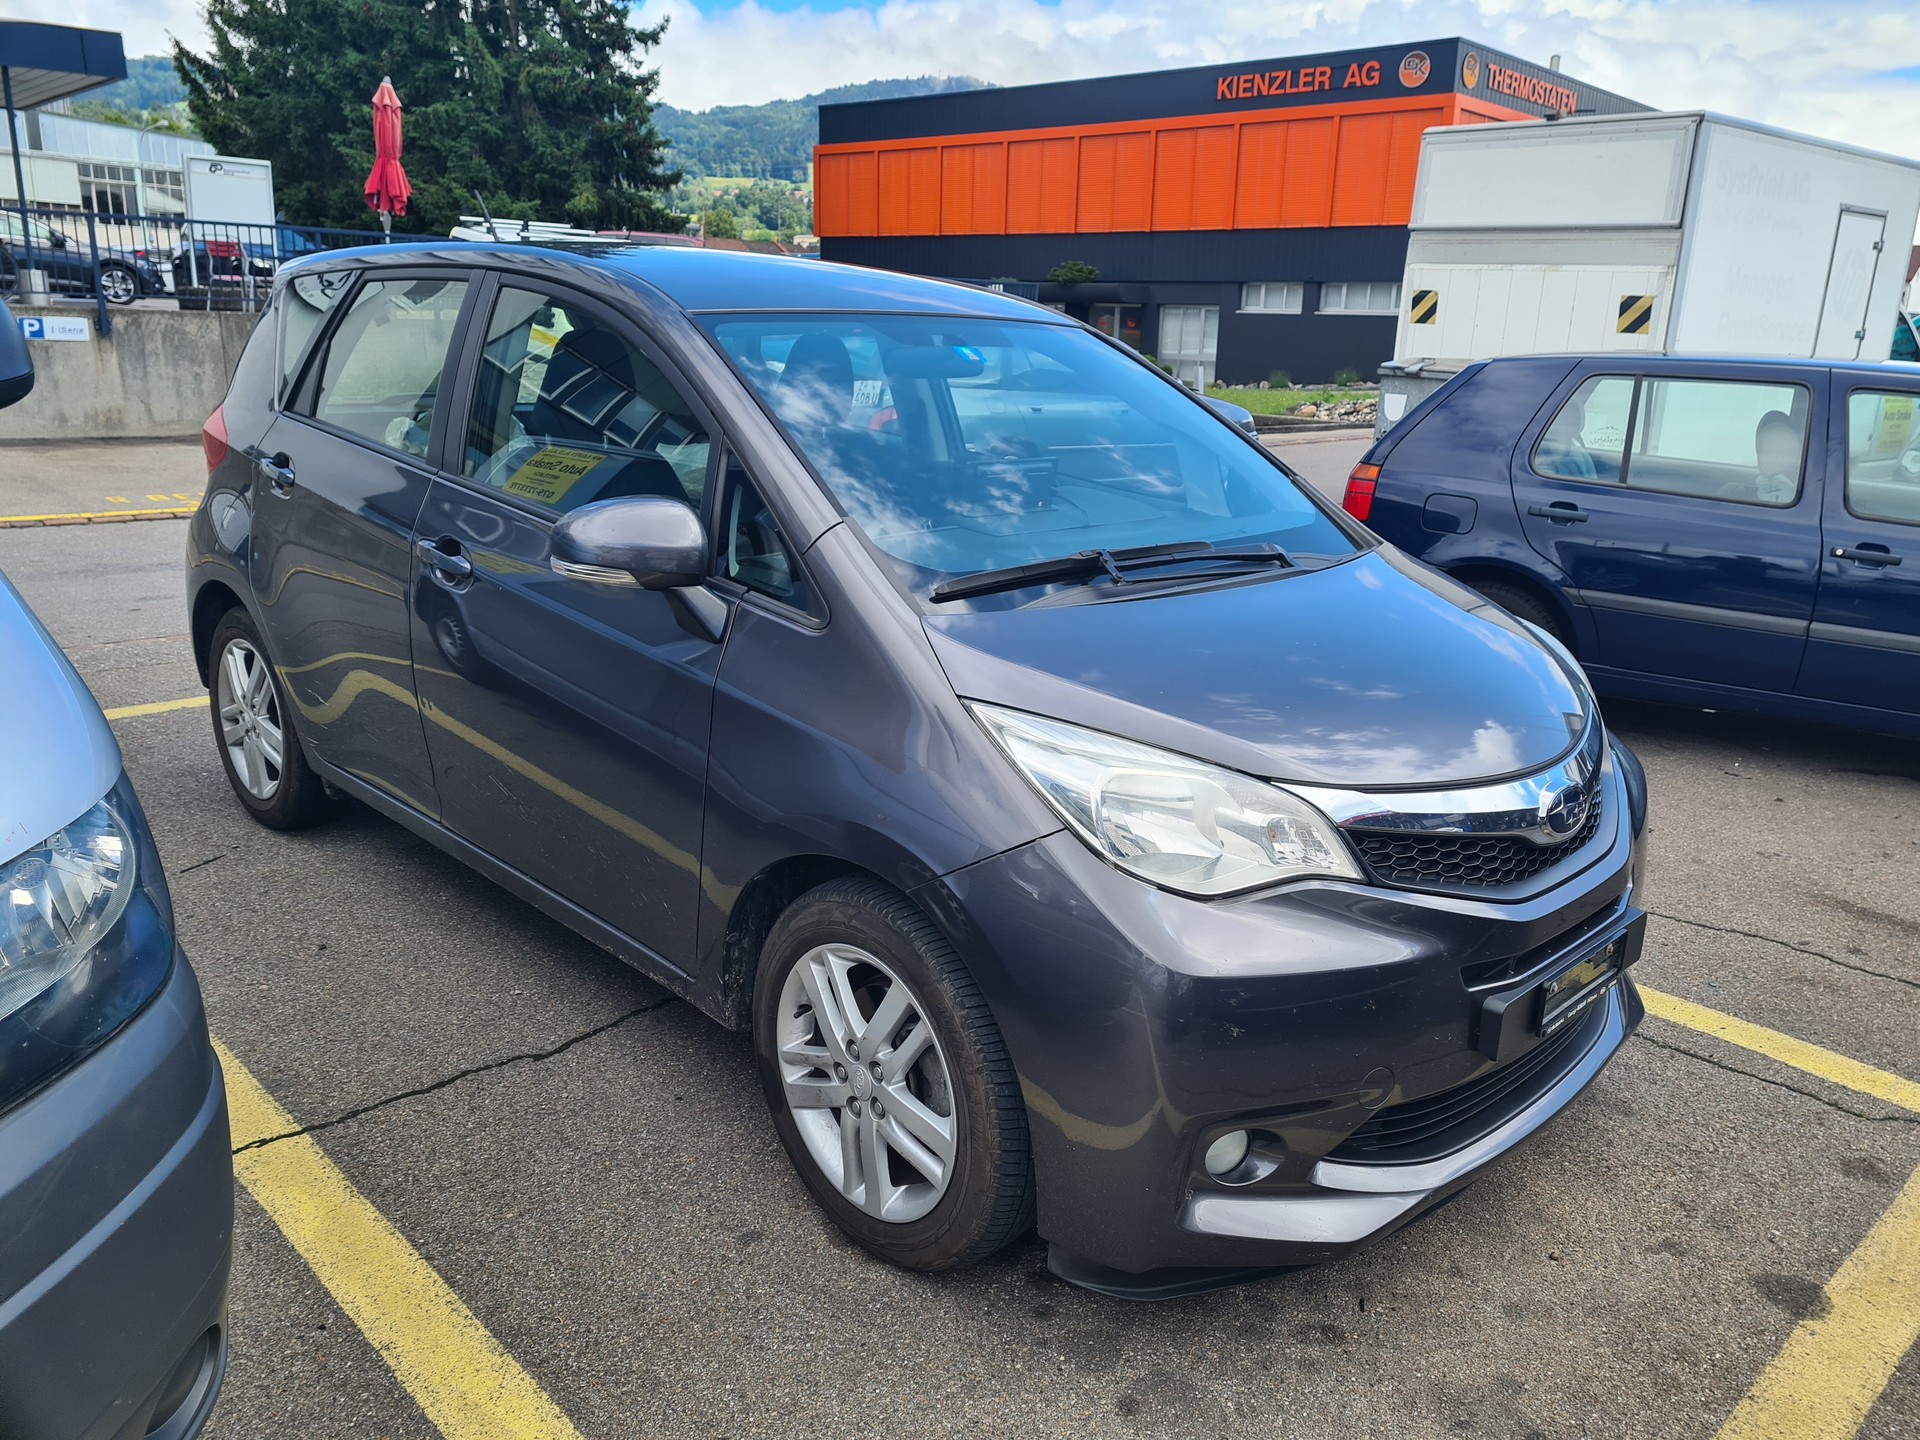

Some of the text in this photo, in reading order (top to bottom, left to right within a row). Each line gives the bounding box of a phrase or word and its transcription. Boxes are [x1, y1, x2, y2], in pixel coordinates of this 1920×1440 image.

[1217, 60, 1381, 101] KIENZLER AG
[1487, 63, 1577, 113] THERMOSTATEN
[1724, 265, 1795, 304] Managed
[23, 318, 40, 339] P
